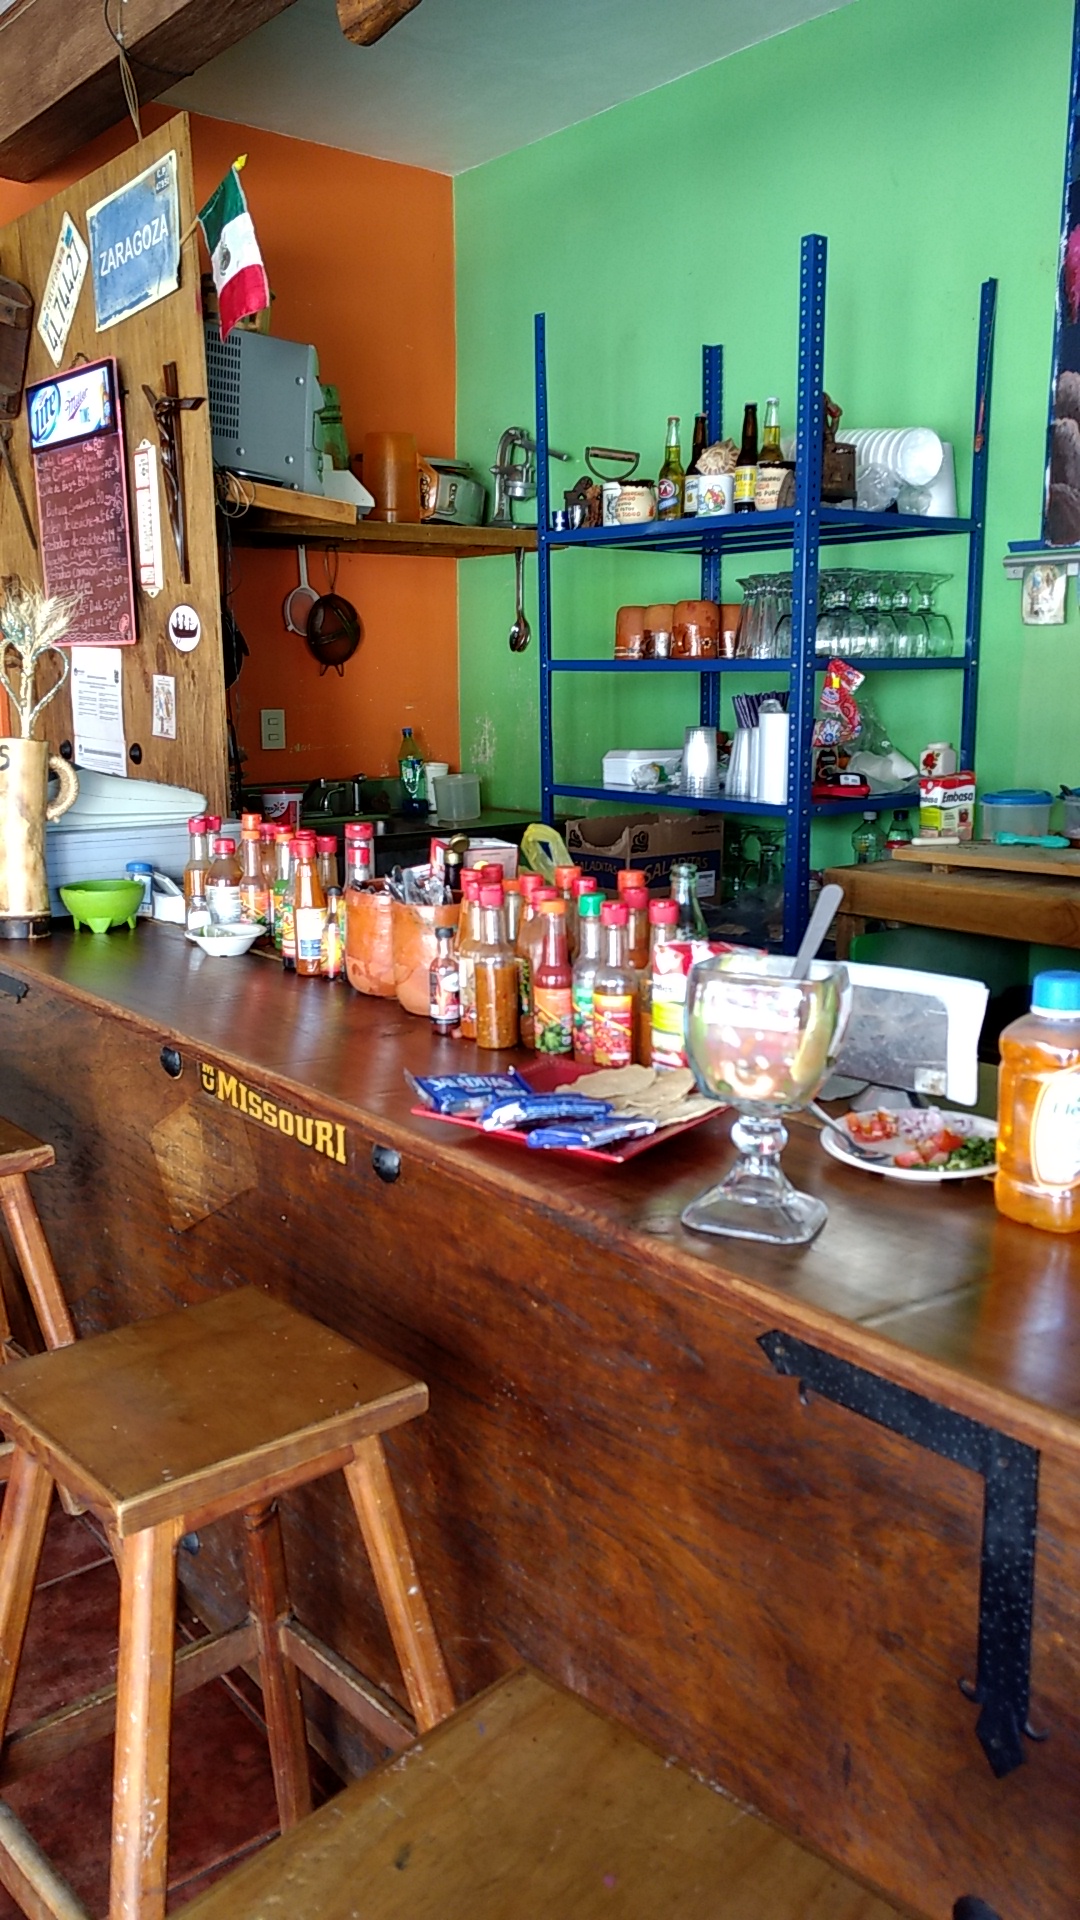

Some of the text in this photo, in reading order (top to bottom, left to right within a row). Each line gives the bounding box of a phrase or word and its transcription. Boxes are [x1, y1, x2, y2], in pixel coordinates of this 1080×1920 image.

[99, 213, 169, 277] ZARAGOZA
[34, 390, 56, 443] Lite
[65, 387, 89, 418] Miller
[941, 791, 974, 804] Embasa
[217, 1069, 347, 1166] MISSOURI
